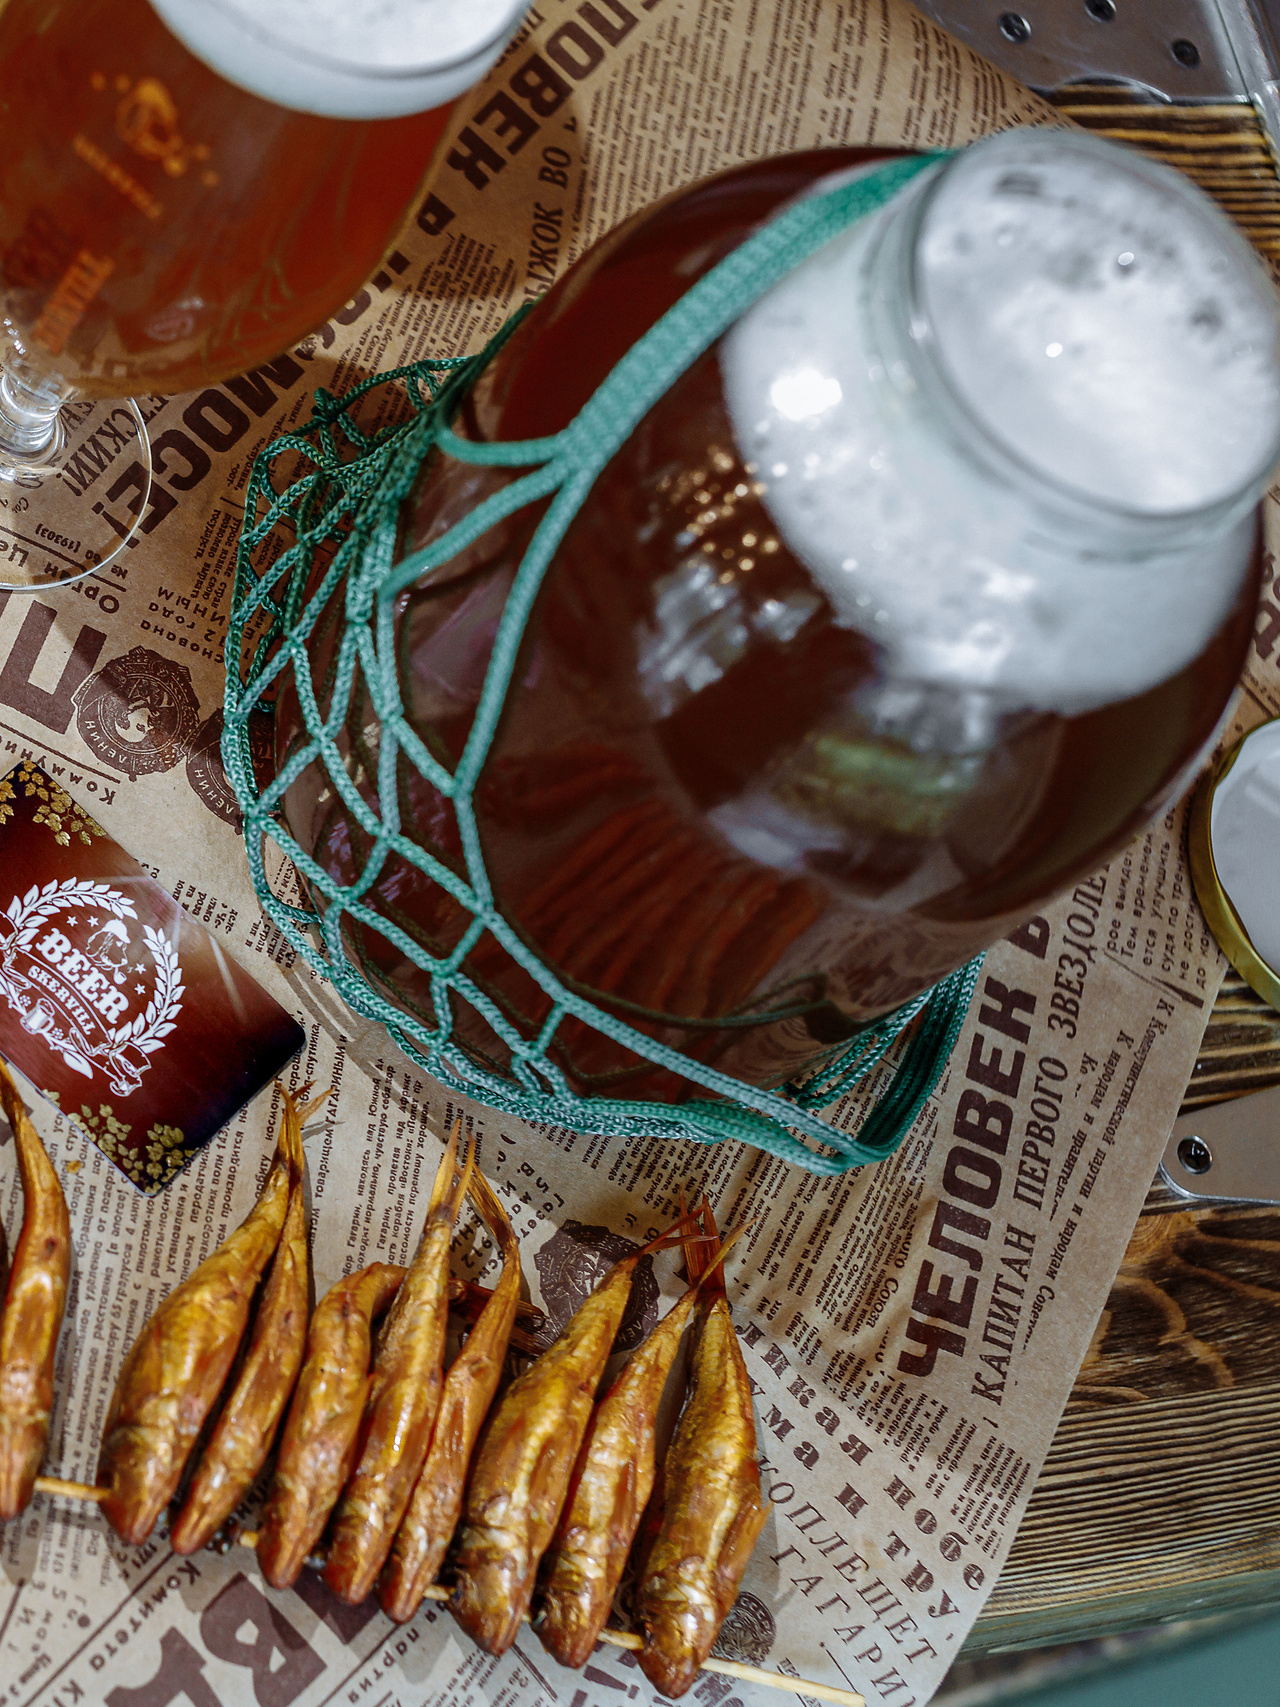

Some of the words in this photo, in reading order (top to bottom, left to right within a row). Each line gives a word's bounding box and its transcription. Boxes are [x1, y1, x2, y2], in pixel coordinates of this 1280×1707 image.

[207, 512, 232, 558] позволено
[40, 562, 119, 613] Орган
[189, 561, 211, 598] вырвать
[148, 601, 195, 629] года
[80, 720, 135, 763] ЛЕНИН
[1114, 833, 1170, 917] временем
[1133, 842, 1180, 919] улучшить
[1120, 926, 1138, 957] Тем
[1142, 928, 1157, 966] ется
[1160, 932, 1175, 972] судя
[35, 928, 128, 1023] BEER
[20, 965, 100, 1034] SKERVILL
[367, 1076, 383, 1116] Южной
[1090, 1049, 1121, 1108] народам
[1102, 1017, 1167, 1145] Коммунистической
[314, 1126, 333, 1198] товарищем
[324, 1043, 350, 1124] ГАГАРИНЫМ
[364, 1122, 377, 1143] над
[211, 1154, 223, 1185] волн
[220, 1130, 243, 1218] производится
[254, 1154, 271, 1200] орбиту
[355, 1148, 372, 1197] находясь
[363, 1163, 381, 1223] нормально,
[372, 1111, 390, 1160] чувствую
[381, 1086, 392, 1110] себя
[642, 1143, 666, 1179] народов,
[660, 1162, 681, 1191] Земле.
[707, 1141, 725, 1170] только
[879, 981, 1066, 1374] ЧЕЛОВЕК
[1078, 1147, 1106, 1198] партии
[375, 1206, 392, 1250] Гагарин,
[384, 1145, 402, 1196] пролетая
[394, 1119, 406, 1140] над
[408, 1152, 424, 1205] переношу
[642, 1168, 663, 1207] службу
[770, 1165, 791, 1199] ученым,
[165, 1195, 186, 1273] установлена
[346, 1204, 362, 1247] Гагарин,
[389, 1192, 406, 1238] корабля
[777, 1207, 804, 1258] советскому
[779, 1200, 797, 1227] всему
[807, 1208, 829, 1249] человека
[962, 1223, 1044, 1405] КАПИТАН
[1013, 1057, 1087, 1208] ПЕРВОГО
[756, 1228, 784, 1275] советскому
[810, 1229, 832, 1264] космоса
[839, 1222, 857, 1254] космос
[869, 1240, 887, 1272] первый
[1045, 1218, 1077, 1280] народам
[842, 1250, 872, 1307] космического
[865, 1276, 898, 1327] Союза
[840, 1272, 872, 1332] искусственный
[869, 1384, 892, 1415] Земле,
[886, 1396, 913, 1436] народов,
[733, 1311, 870, 1463] ликая
[884, 1475, 984, 1590] побе
[912, 1435, 930, 1462] этого
[990, 1447, 1015, 1488] прочный
[834, 1482, 867, 1518] и
[962, 1462, 983, 1492] наций,
[745, 1456, 935, 1660] КОПЛЕЩЕТ
[90, 1558, 202, 1669] Комитета
[766, 1545, 915, 1707] ГАГАРИ
[338, 1625, 421, 1702] партия
